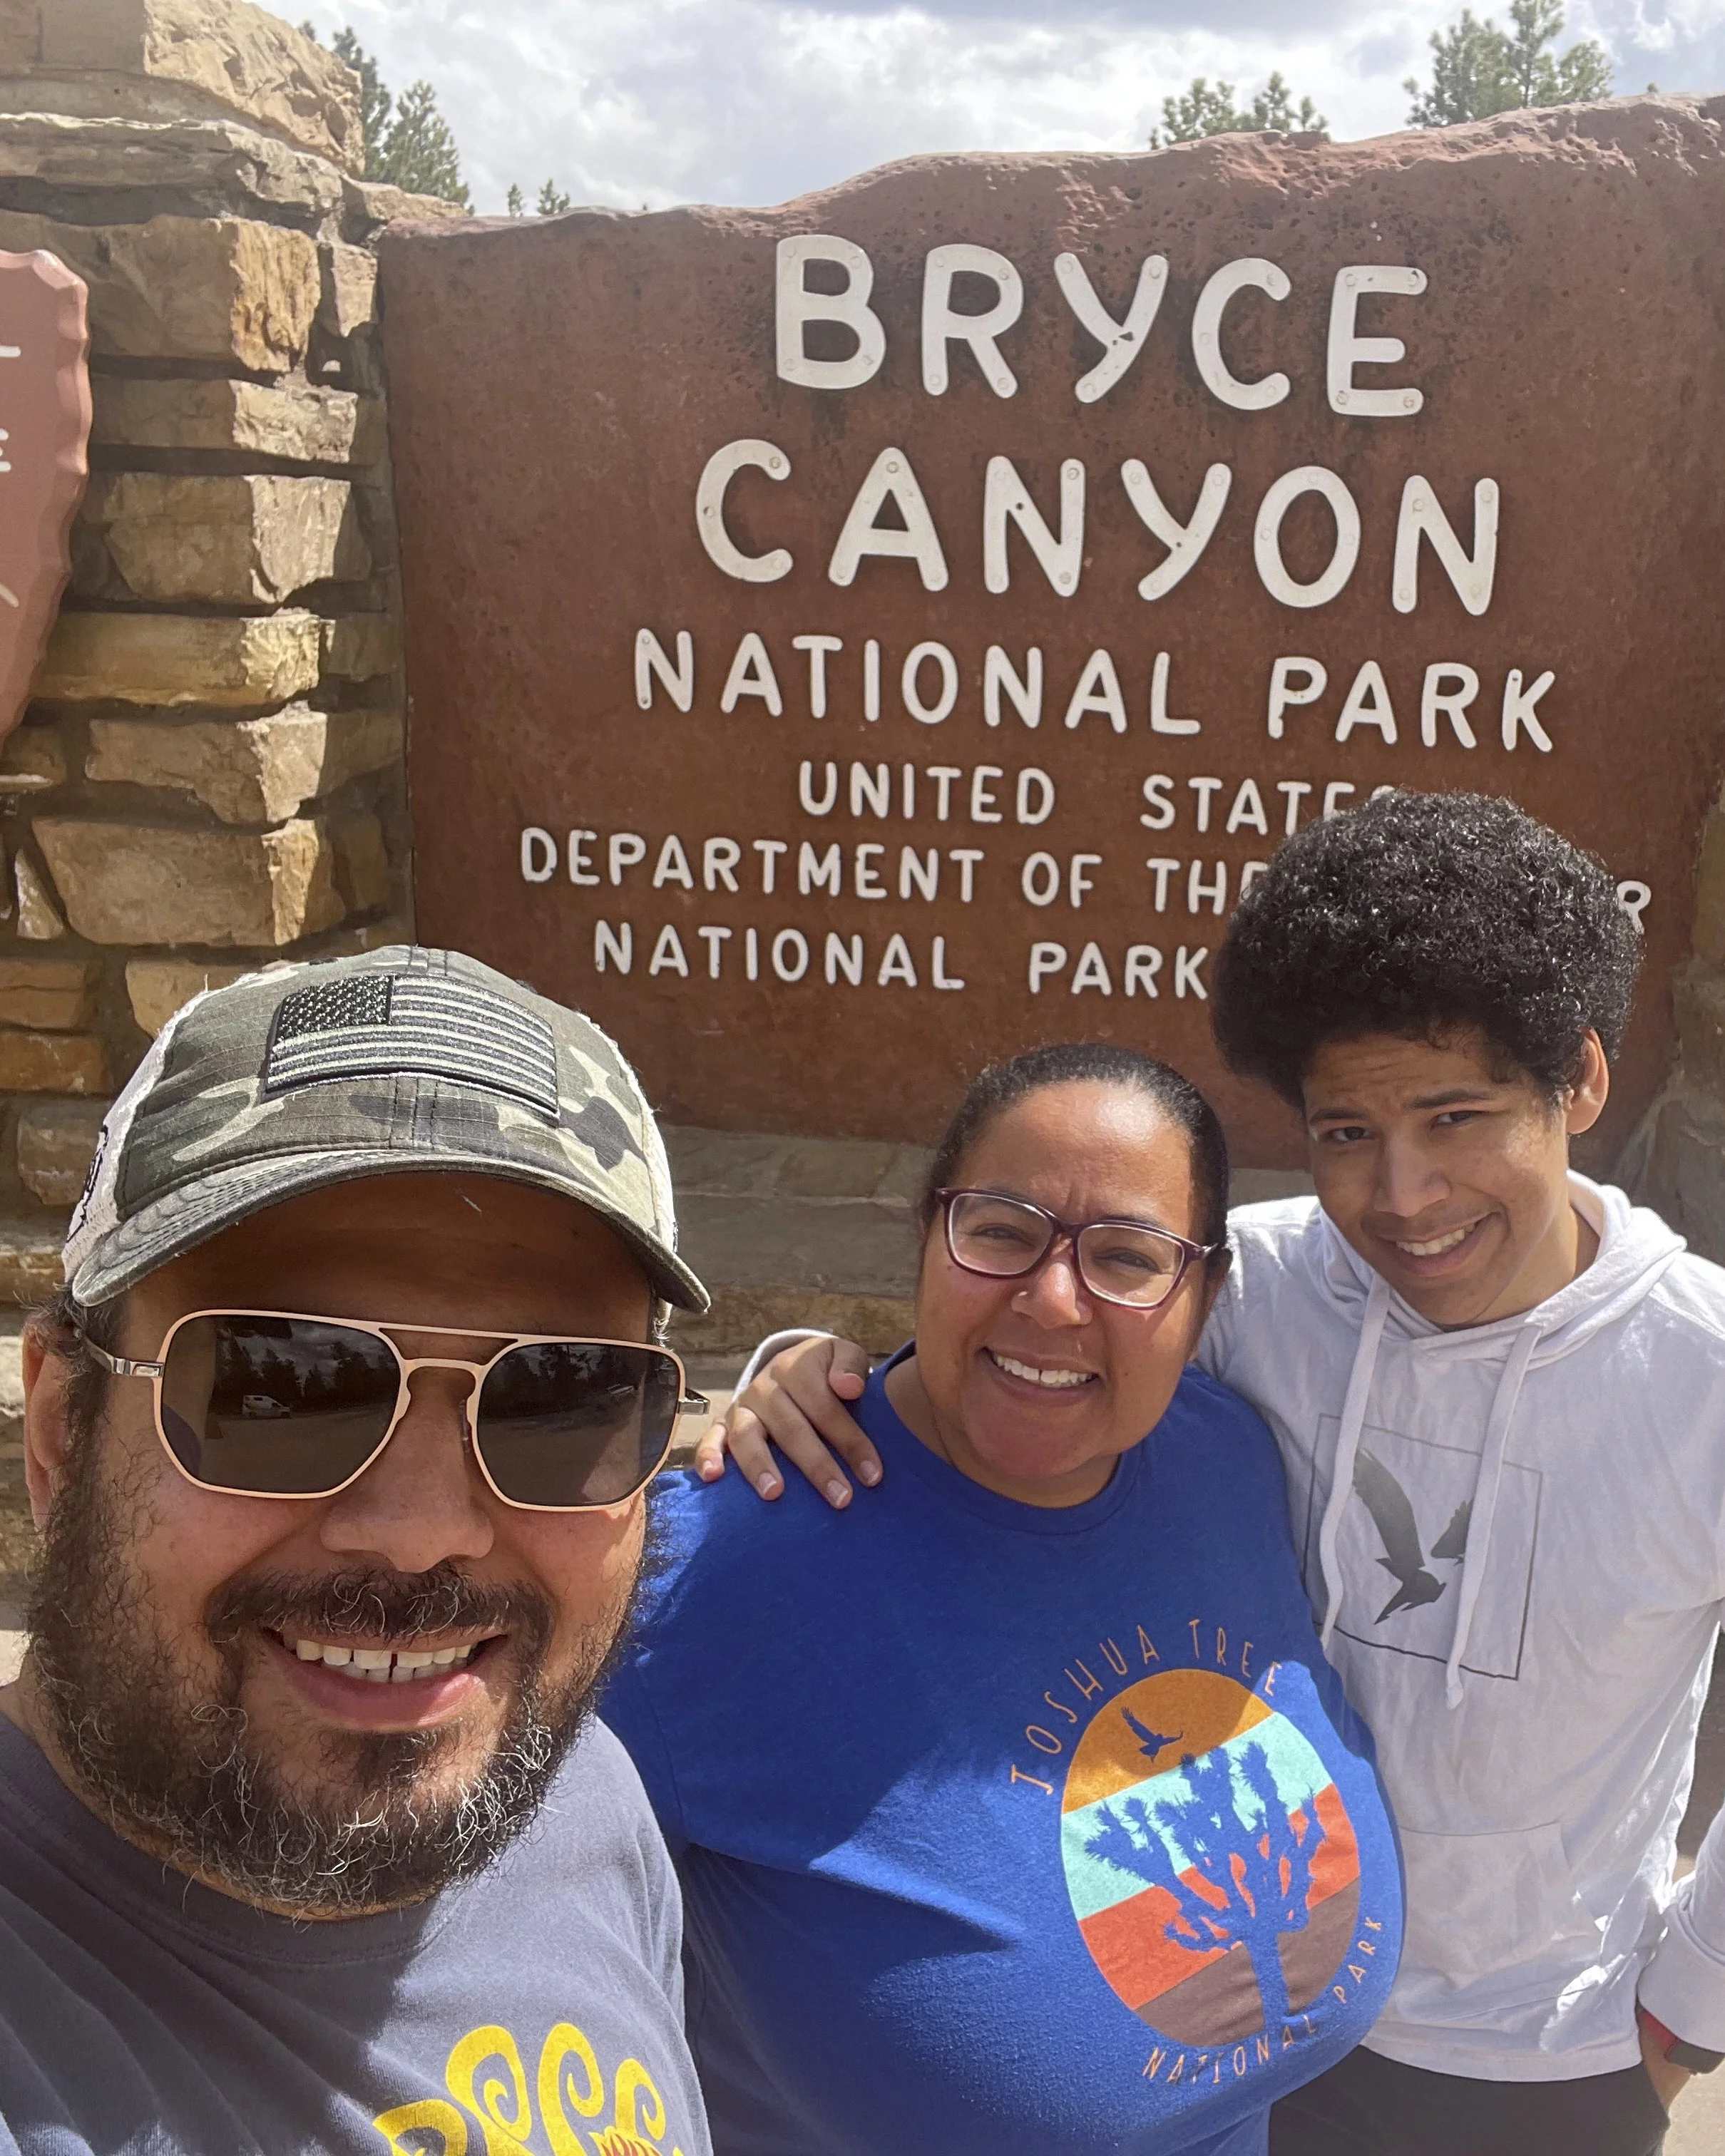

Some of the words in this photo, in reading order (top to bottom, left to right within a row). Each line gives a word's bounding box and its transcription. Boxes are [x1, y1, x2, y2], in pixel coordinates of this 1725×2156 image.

[775, 233, 1428, 417] BRYCE
[696, 438, 1499, 616] CANYON
[635, 628, 1201, 738] NATIONAL
[1268, 657, 1556, 753] PARK
[800, 761, 1055, 825] UNITED
[521, 828, 985, 904] DEPARTMENT
[1022, 852, 1103, 909] OF
[595, 920, 966, 990] NATIONAL
[1030, 943, 1209, 1000] PARK
[1010, 1624, 1160, 1796] JOSHUA
[1189, 1618, 1283, 1697] TREE
[1142, 2013, 1316, 2085] NATIONAL
[1332, 1916, 1381, 2005] PARK
